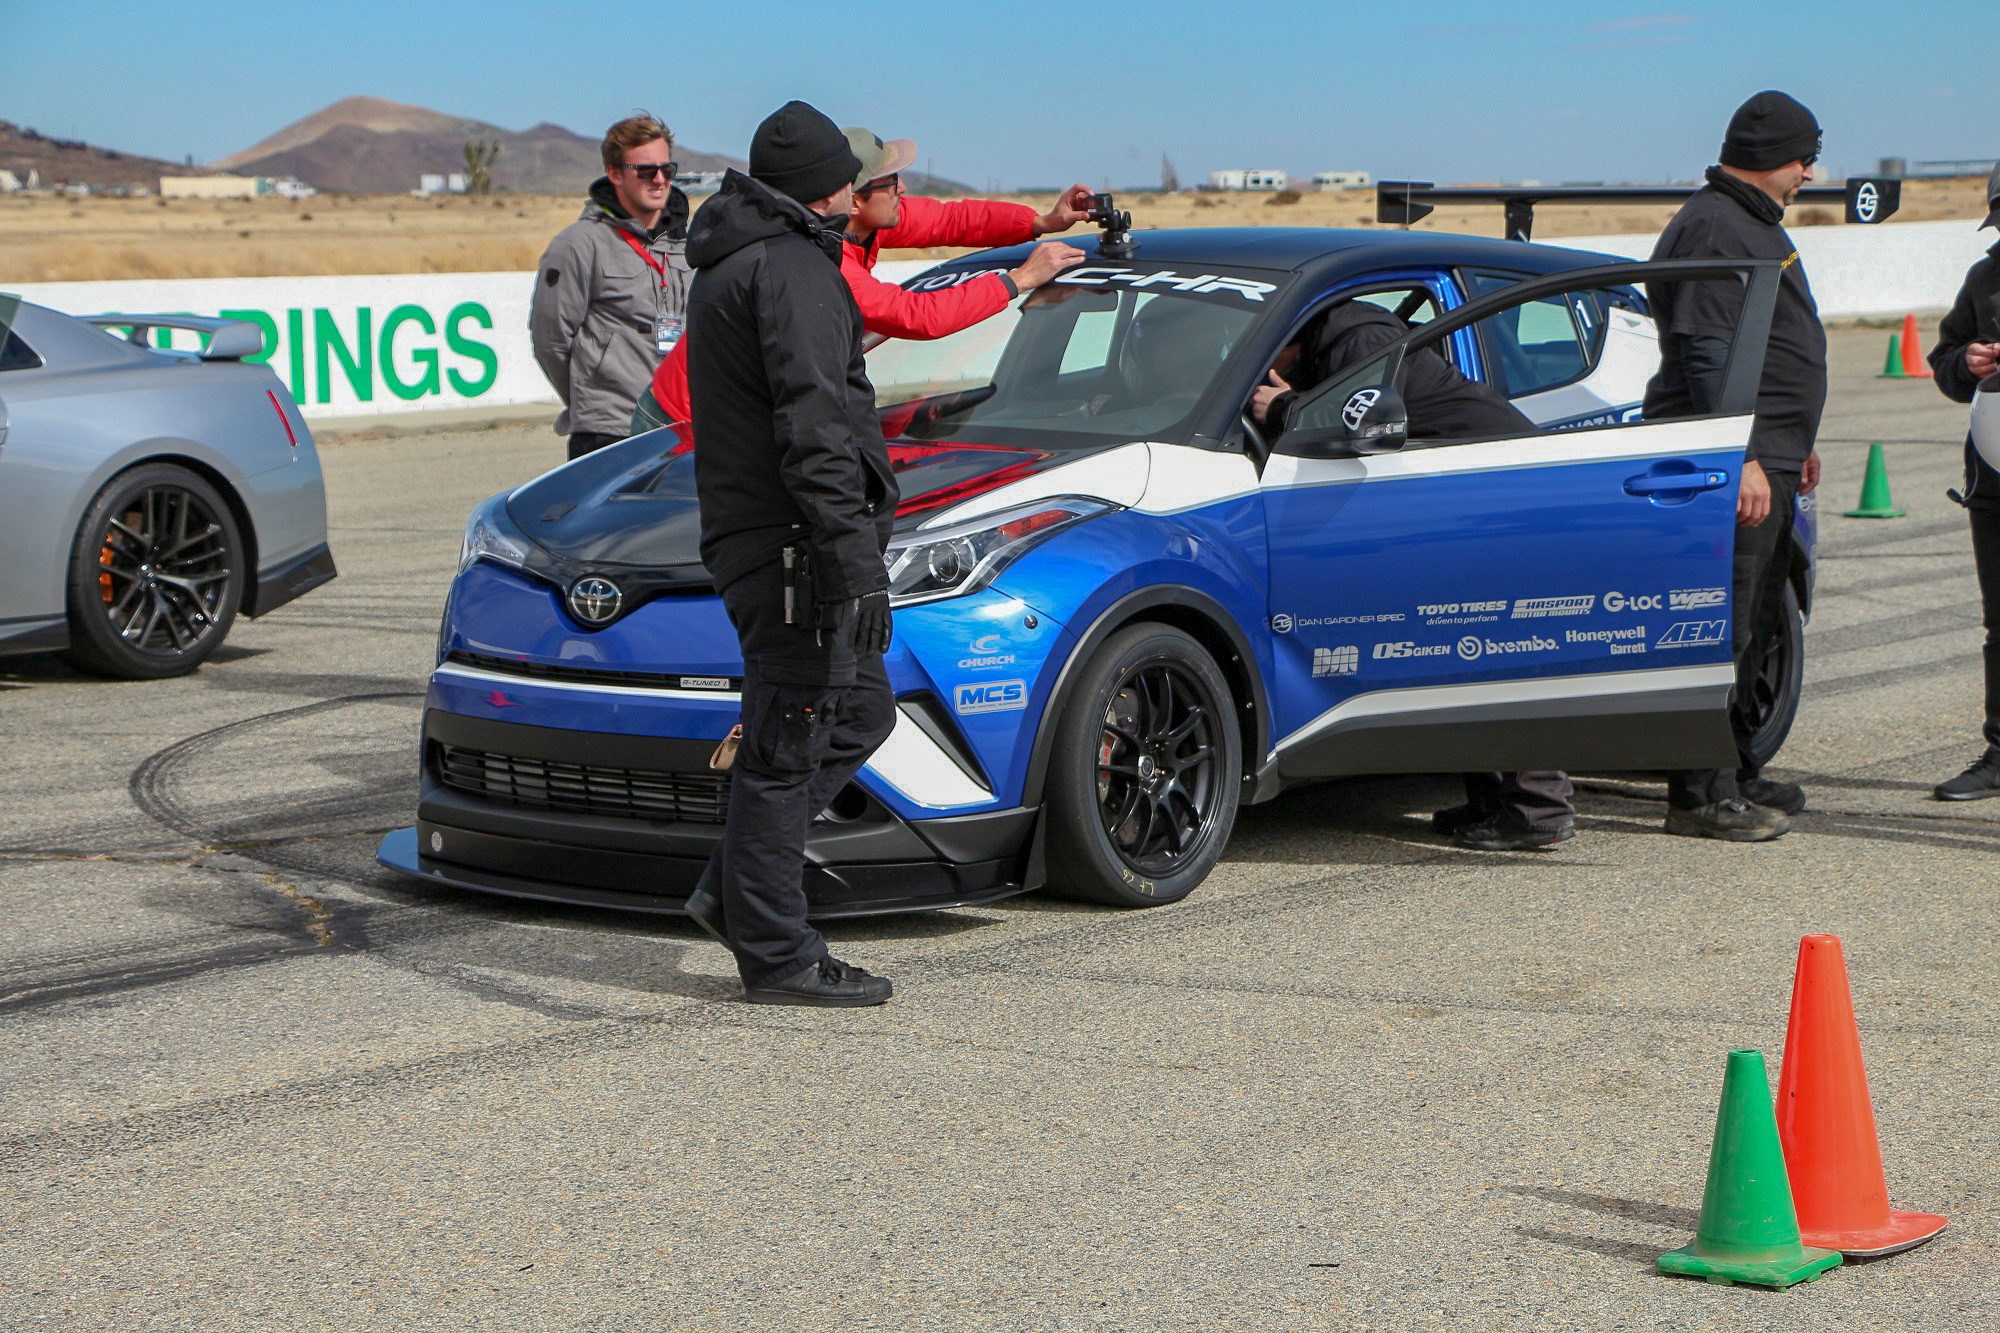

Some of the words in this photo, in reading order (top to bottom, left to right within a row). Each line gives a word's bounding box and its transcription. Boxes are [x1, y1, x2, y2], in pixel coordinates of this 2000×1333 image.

[904, 268, 1017, 292] TOY
[1055, 267, 1278, 301] C-HR
[98, 302, 498, 406] INGS
[1417, 603, 1460, 616] TOYO
[1461, 600, 1508, 613] TIRES
[1603, 591, 1662, 612] G-LOC
[1299, 618, 1322, 626] DAN
[1323, 615, 1375, 625] GARDNER
[1376, 613, 1406, 622] SPEC
[1426, 616, 1453, 626] driven
[1454, 616, 1463, 624] to
[1463, 615, 1498, 625] perform
[1565, 625, 1646, 643] Honeywell
[1610, 642, 1646, 655] Garrett
[958, 655, 1015, 668] CHURCH
[960, 684, 1022, 705] MCS
